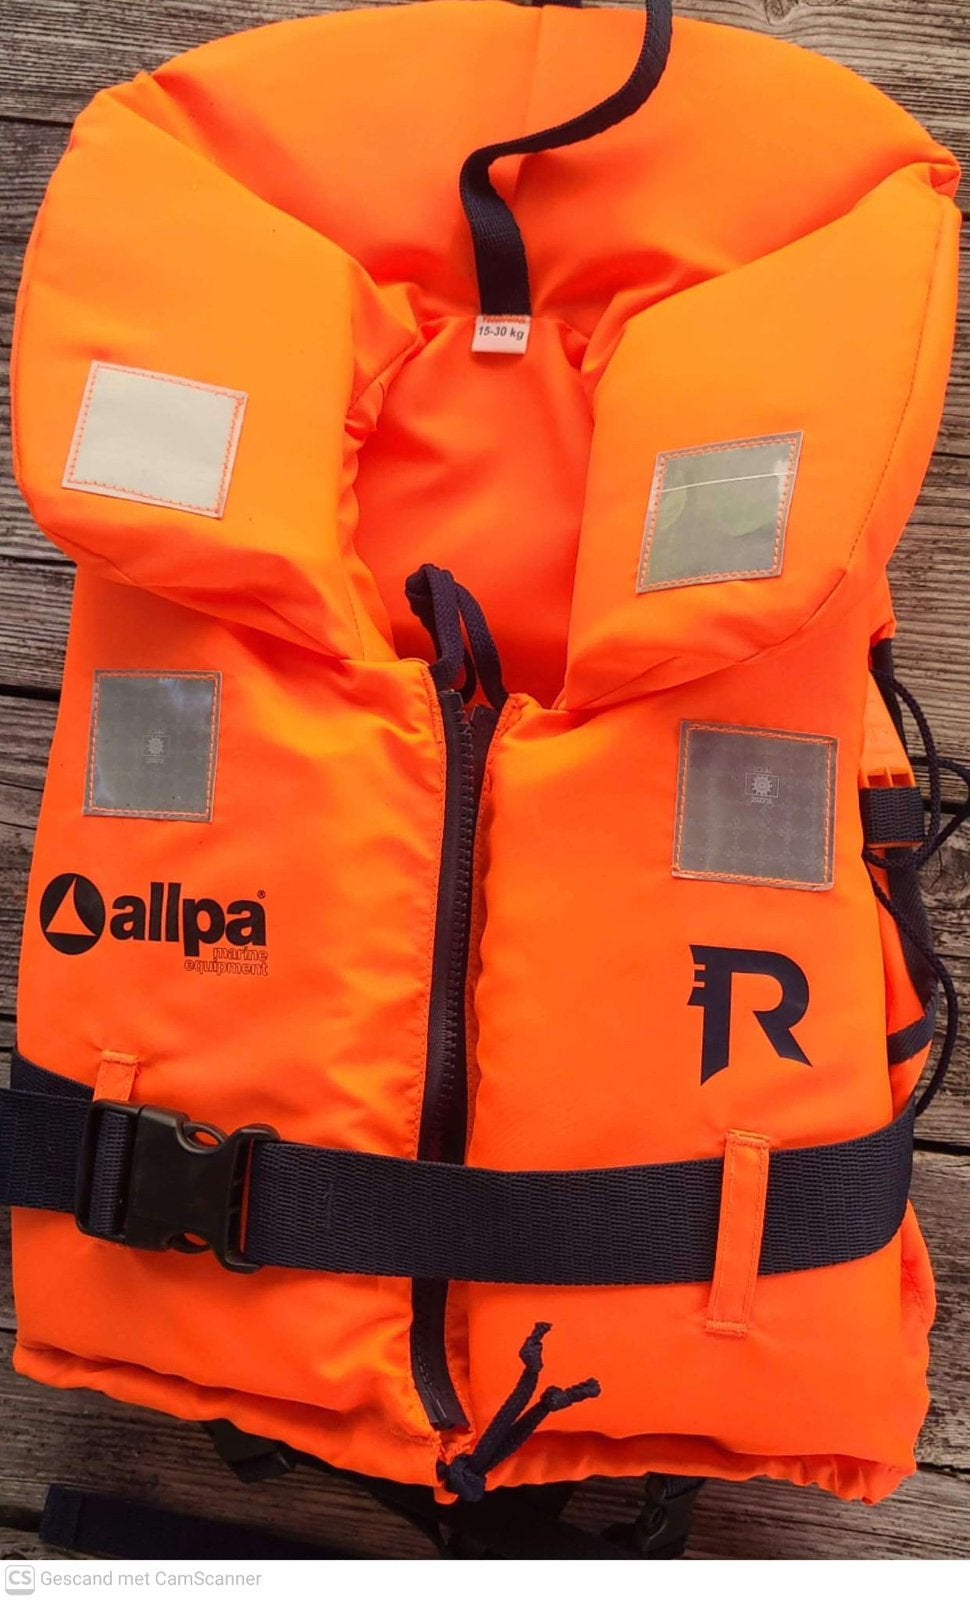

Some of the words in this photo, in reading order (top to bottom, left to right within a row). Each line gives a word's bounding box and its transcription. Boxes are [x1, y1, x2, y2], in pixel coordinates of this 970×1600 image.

[479, 326, 507, 336] 15-30
[510, 327, 524, 341] kg
[213, 946, 268, 962] marine
[184, 959, 268, 976] equipment
